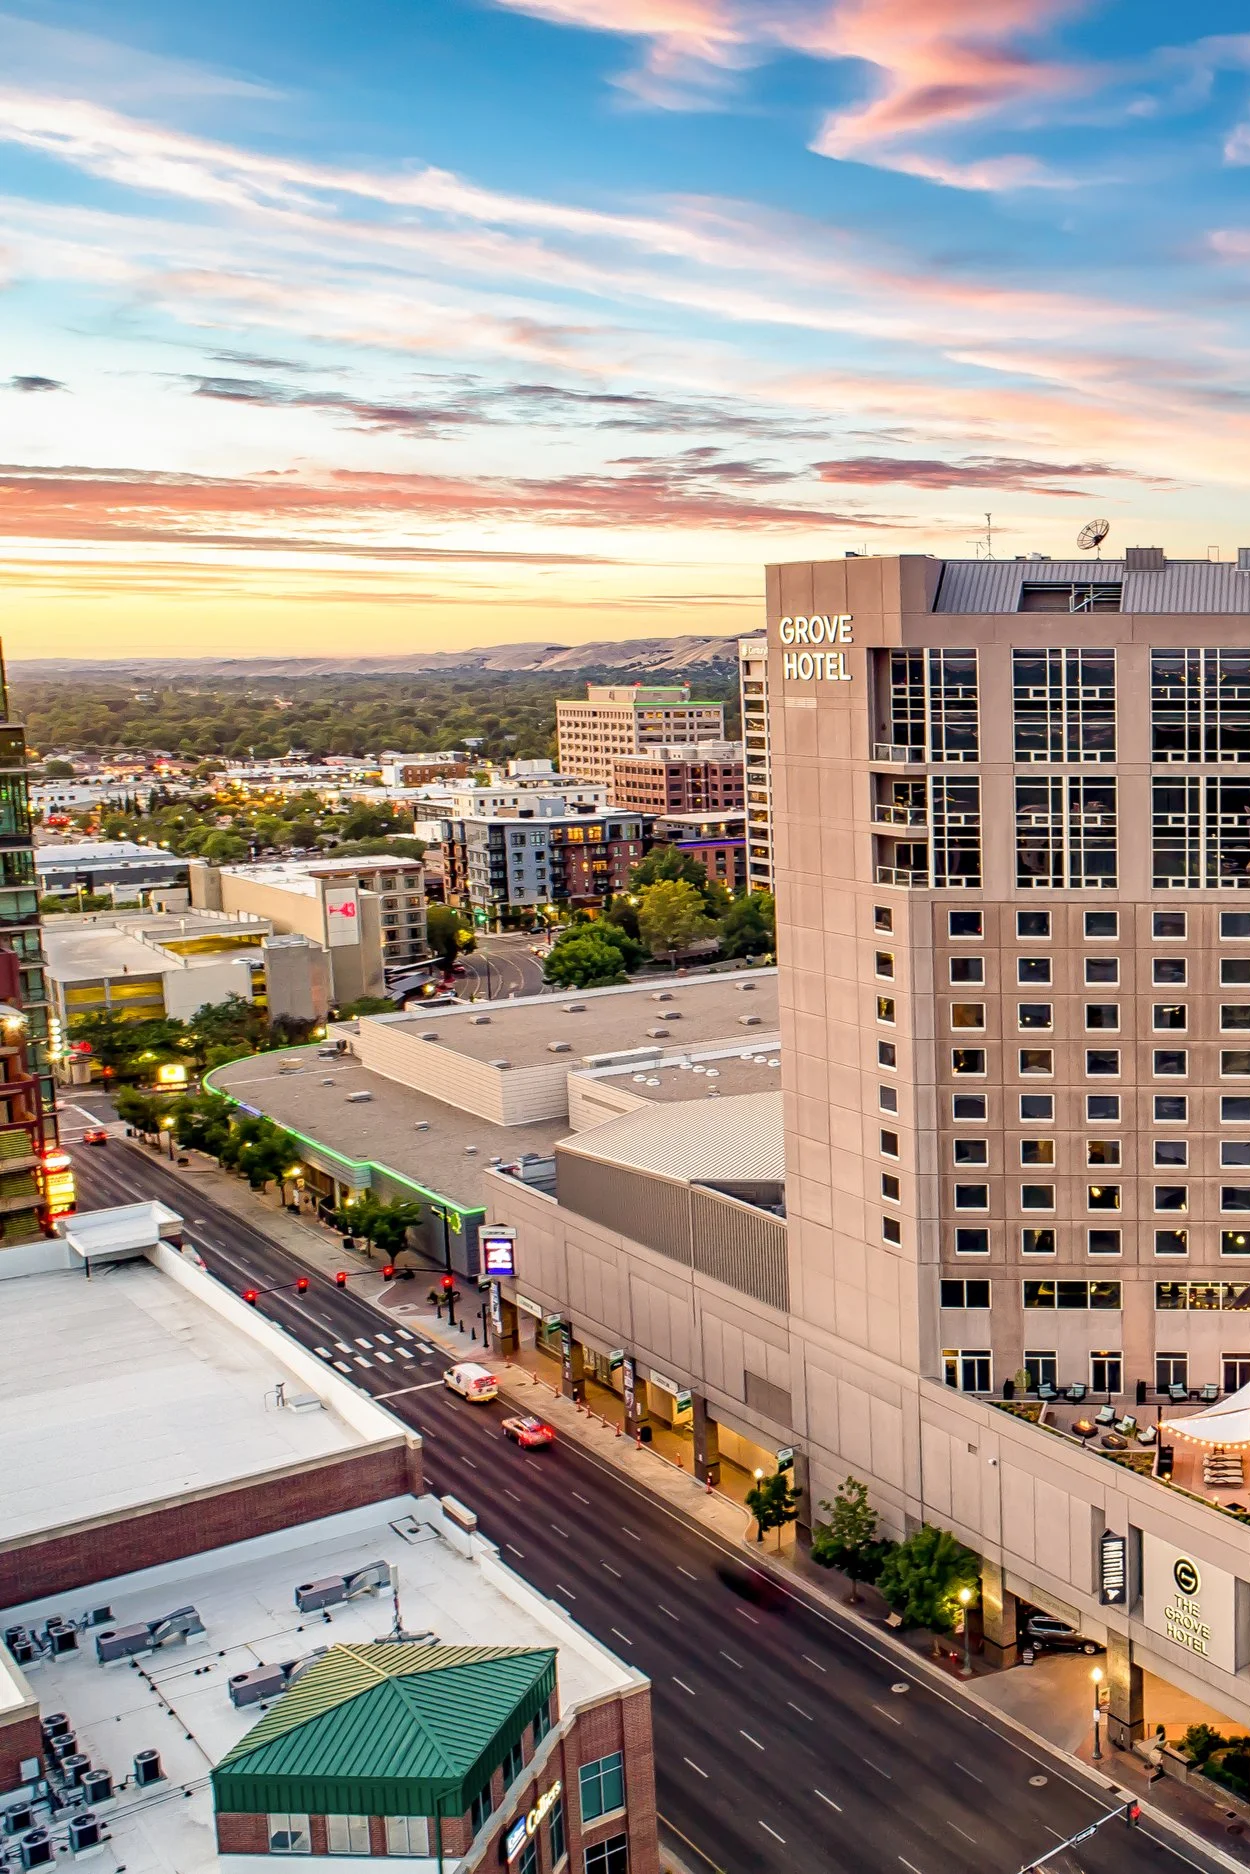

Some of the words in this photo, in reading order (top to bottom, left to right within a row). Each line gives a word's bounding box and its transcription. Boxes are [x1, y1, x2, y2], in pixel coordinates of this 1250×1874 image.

[779, 614, 854, 645] GROVE
[783, 652, 854, 681] HOTEL
[1103, 1541, 1124, 1589] TRILLIUM
[1174, 1594, 1201, 1619] THE
[1164, 1606, 1211, 1640] GROVE
[1166, 1622, 1209, 1657] HOTEL
